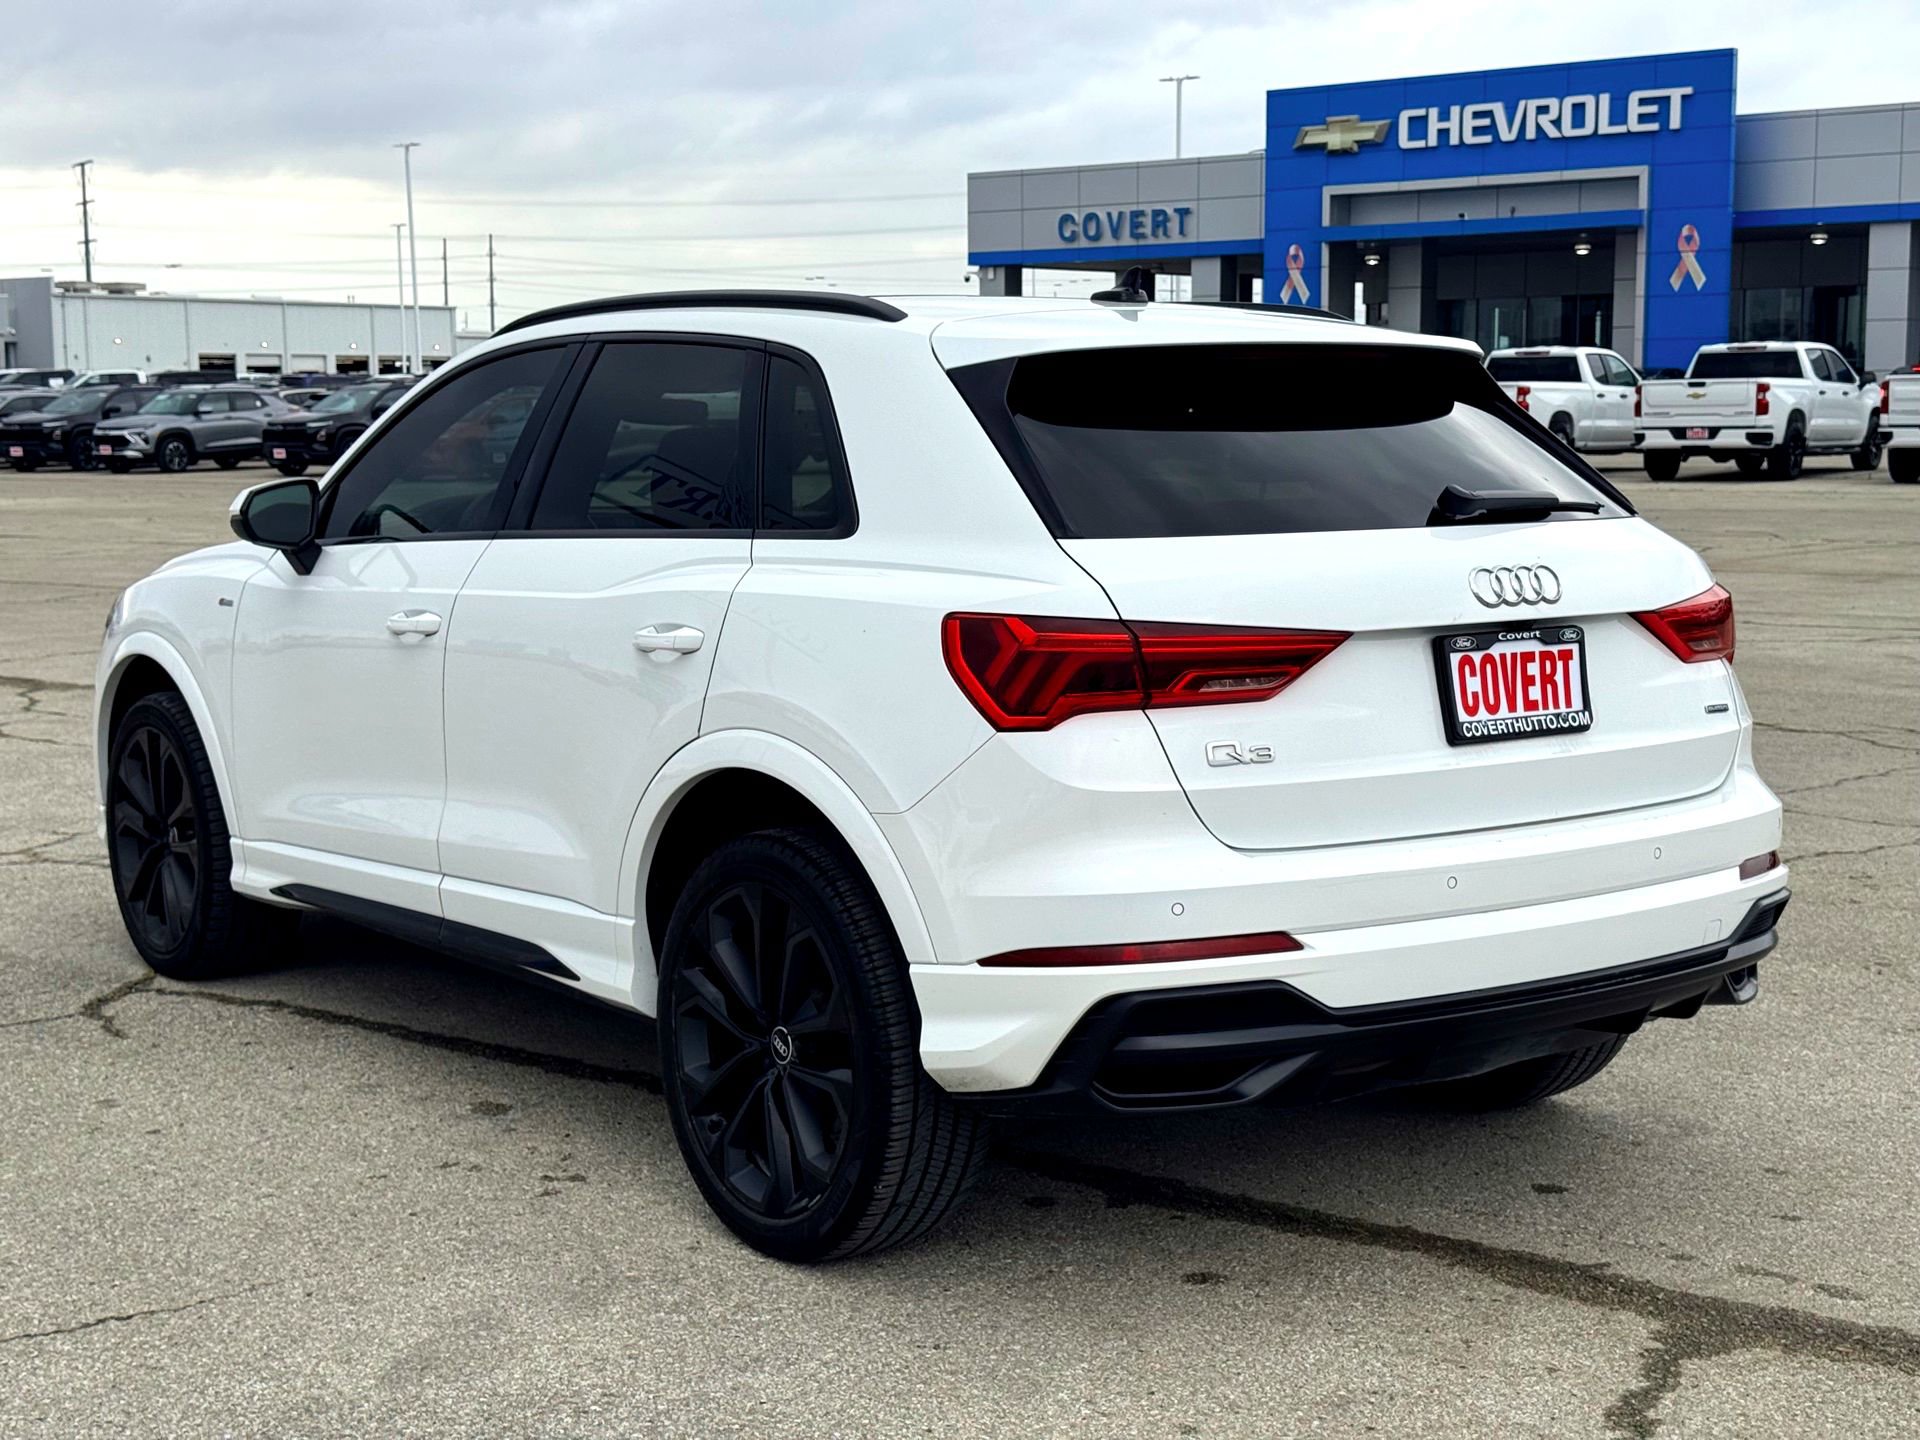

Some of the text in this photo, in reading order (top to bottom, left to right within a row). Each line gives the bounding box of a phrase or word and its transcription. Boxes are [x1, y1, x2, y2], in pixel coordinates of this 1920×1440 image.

[1398, 86, 1693, 150] CHEVROLET
[1058, 207, 1191, 242] COVERT
[1498, 630, 1541, 641] Covert
[1458, 648, 1573, 717] COVERT
[1463, 711, 1591, 738] COVERTHUTTO.COM
[1205, 740, 1275, 767] Q3
